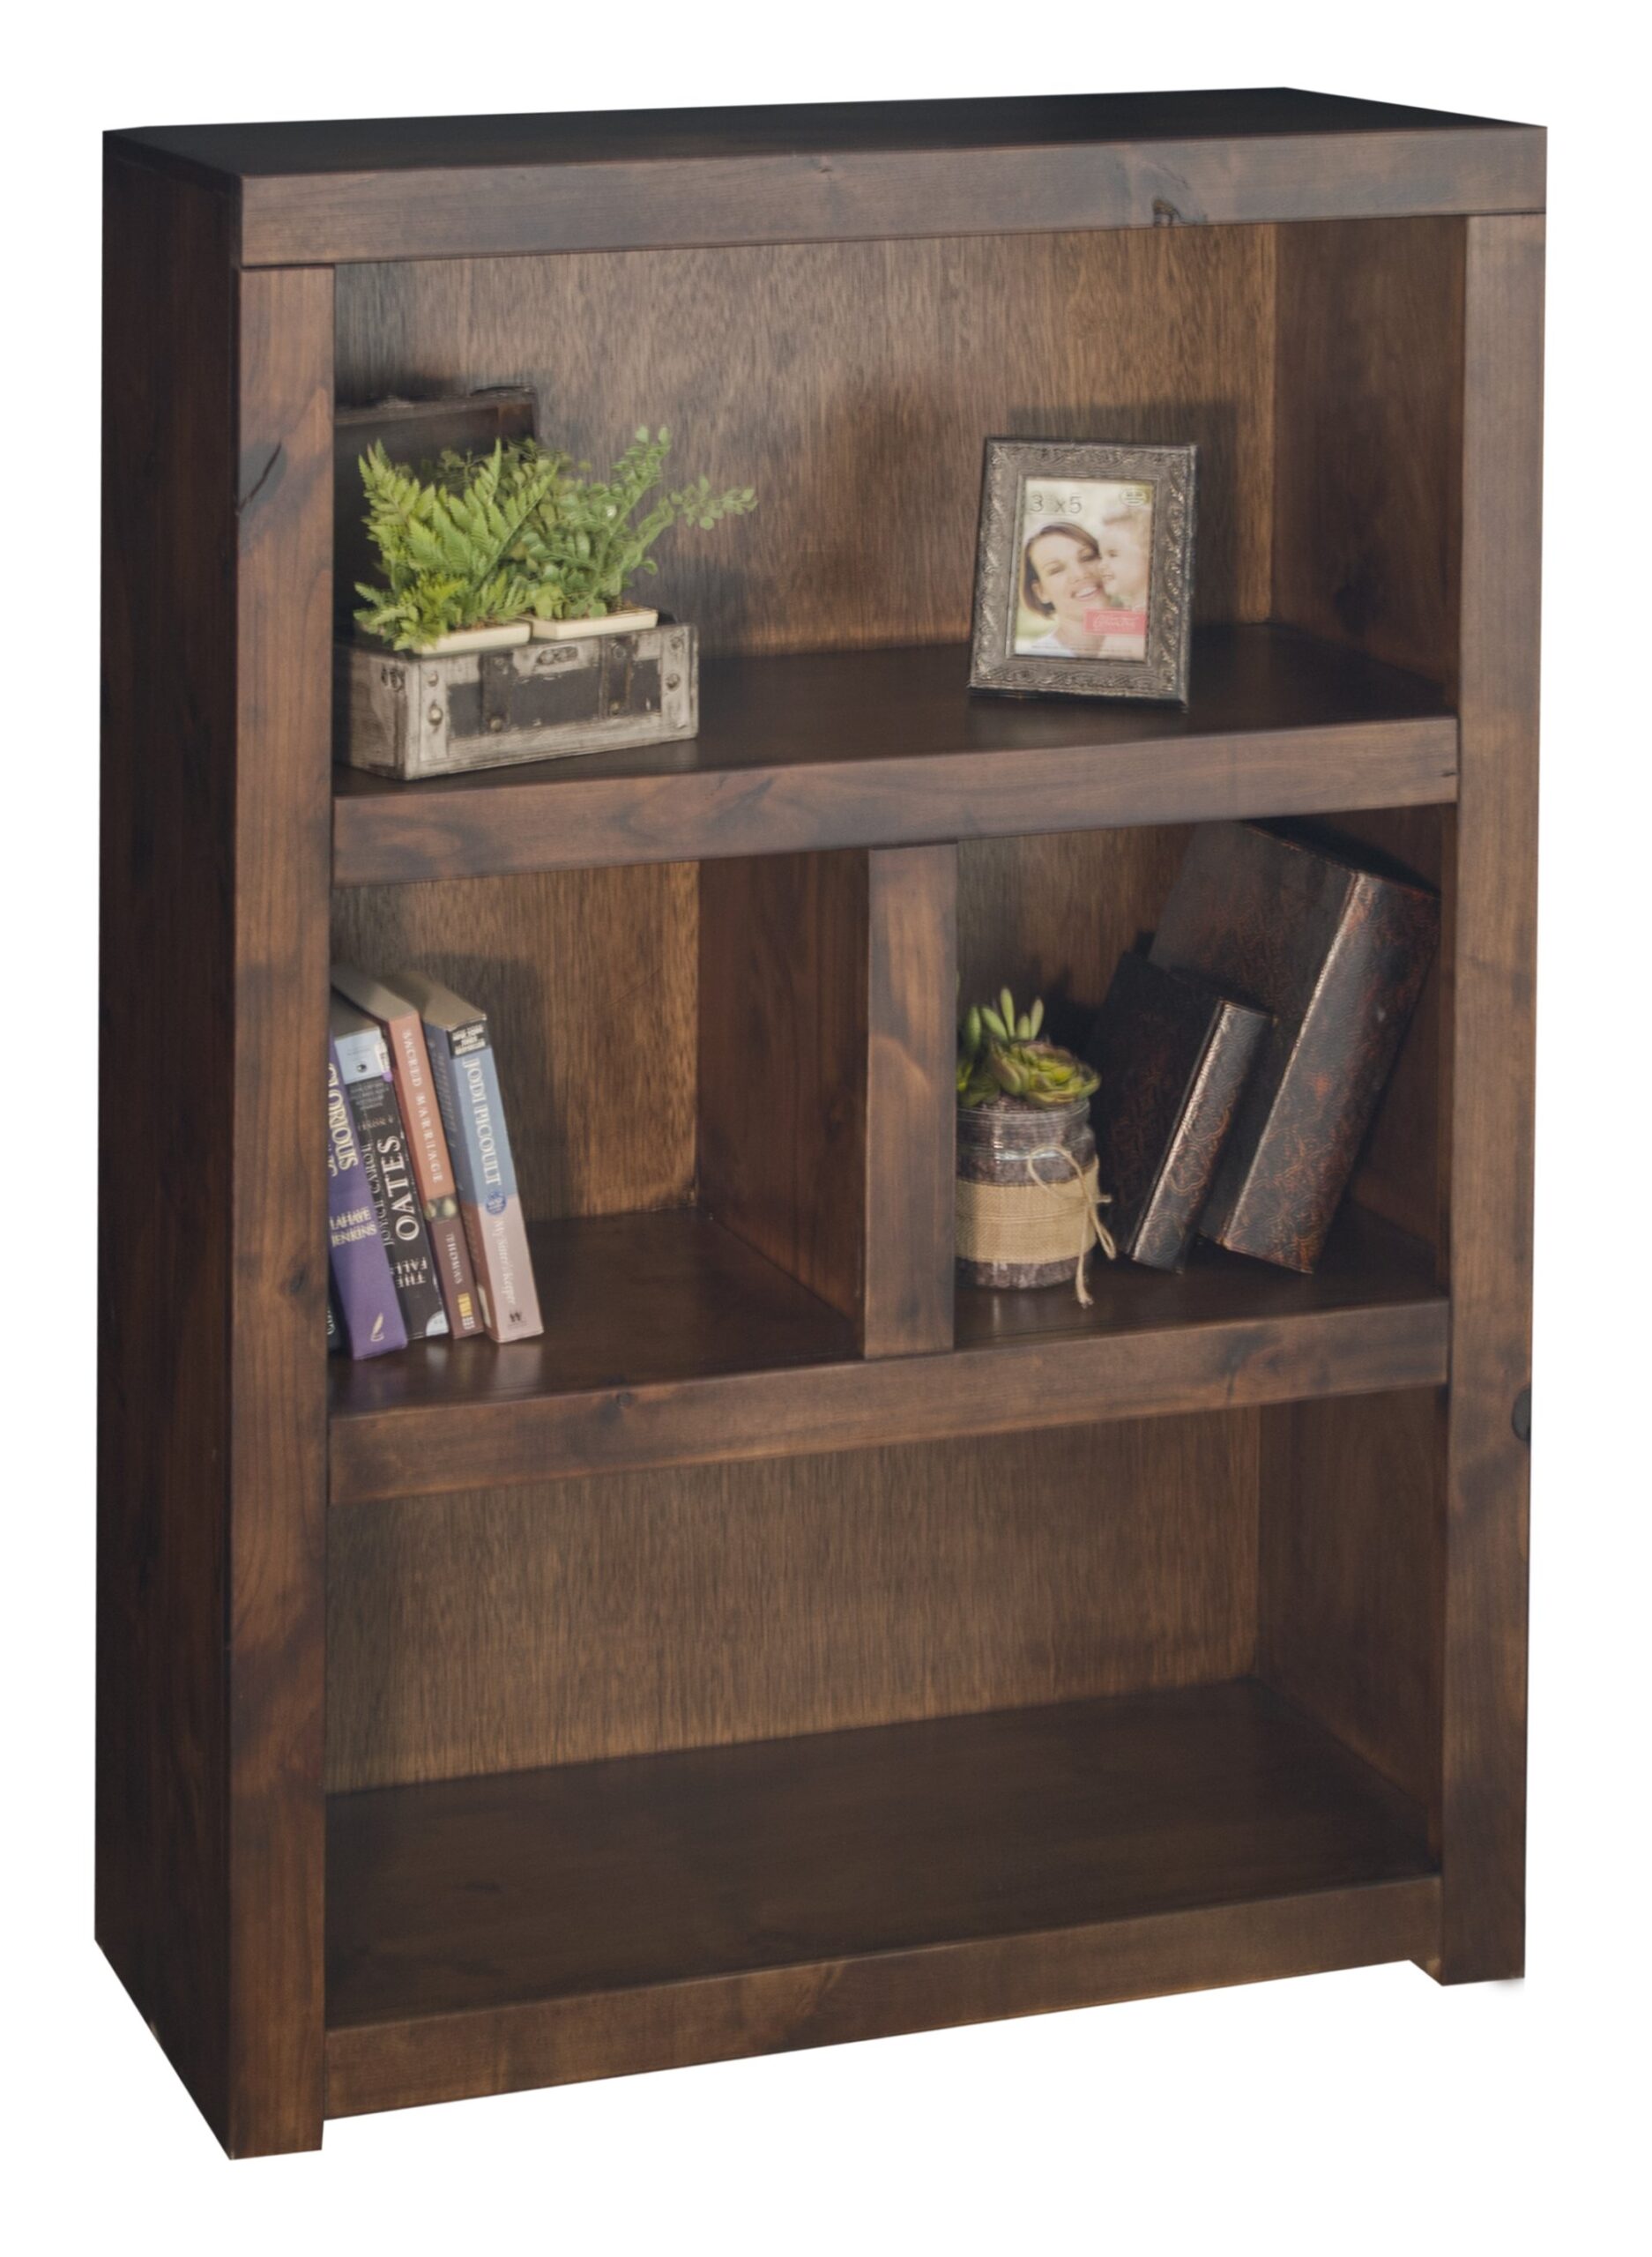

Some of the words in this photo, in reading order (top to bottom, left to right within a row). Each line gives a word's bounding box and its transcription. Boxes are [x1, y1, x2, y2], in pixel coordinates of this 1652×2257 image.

[1031, 492, 1044, 512] 3
[1069, 495, 1083, 514] 5
[462, 1057, 486, 1103] JODI
[473, 1105, 502, 1186] PICOULT
[377, 1135, 420, 1240] OATES
